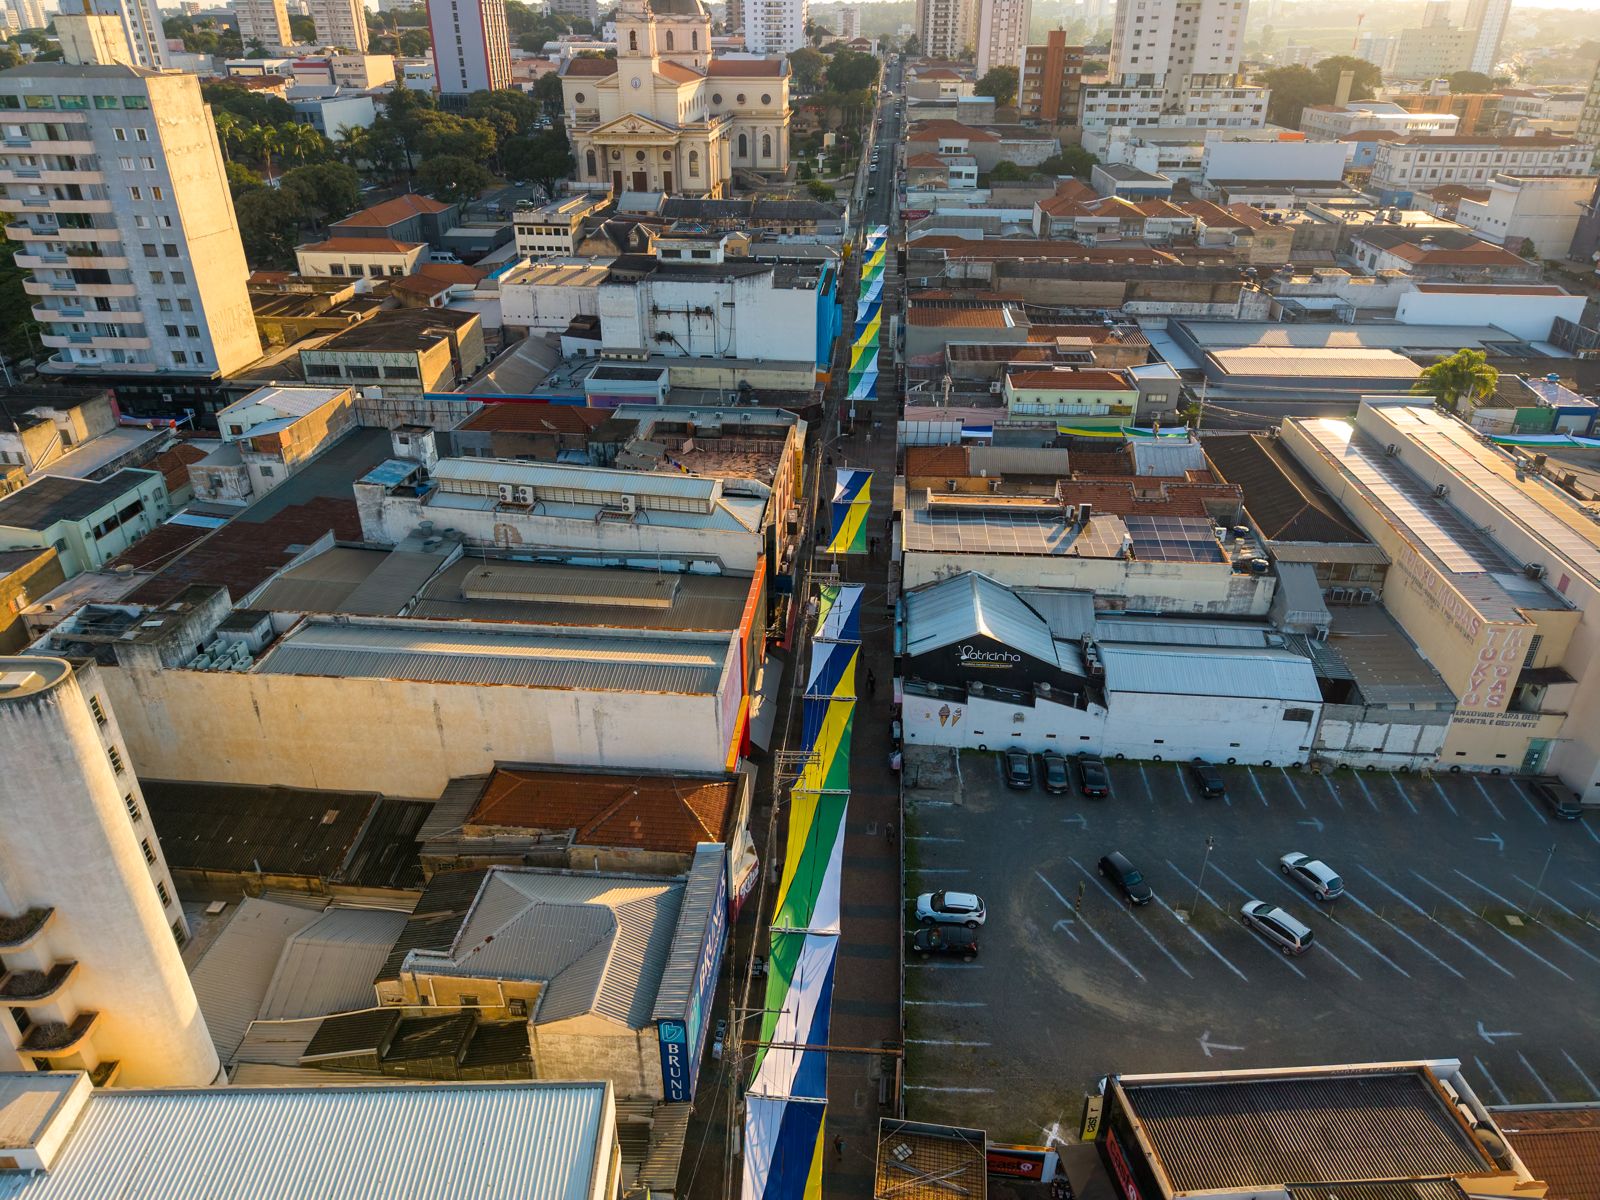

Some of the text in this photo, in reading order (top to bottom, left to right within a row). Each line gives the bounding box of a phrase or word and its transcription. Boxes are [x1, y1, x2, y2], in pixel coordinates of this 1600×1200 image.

[959, 645, 1020, 661] Patricinha
[1462, 627, 1507, 706] TOKYO
[1485, 628, 1522, 708] MODAS
[1453, 717, 1487, 725] INFANTIL
[1494, 720, 1537, 728] GESTANTE
[1496, 712, 1519, 720] PARA
[668, 1044, 683, 1100] BRUNU
